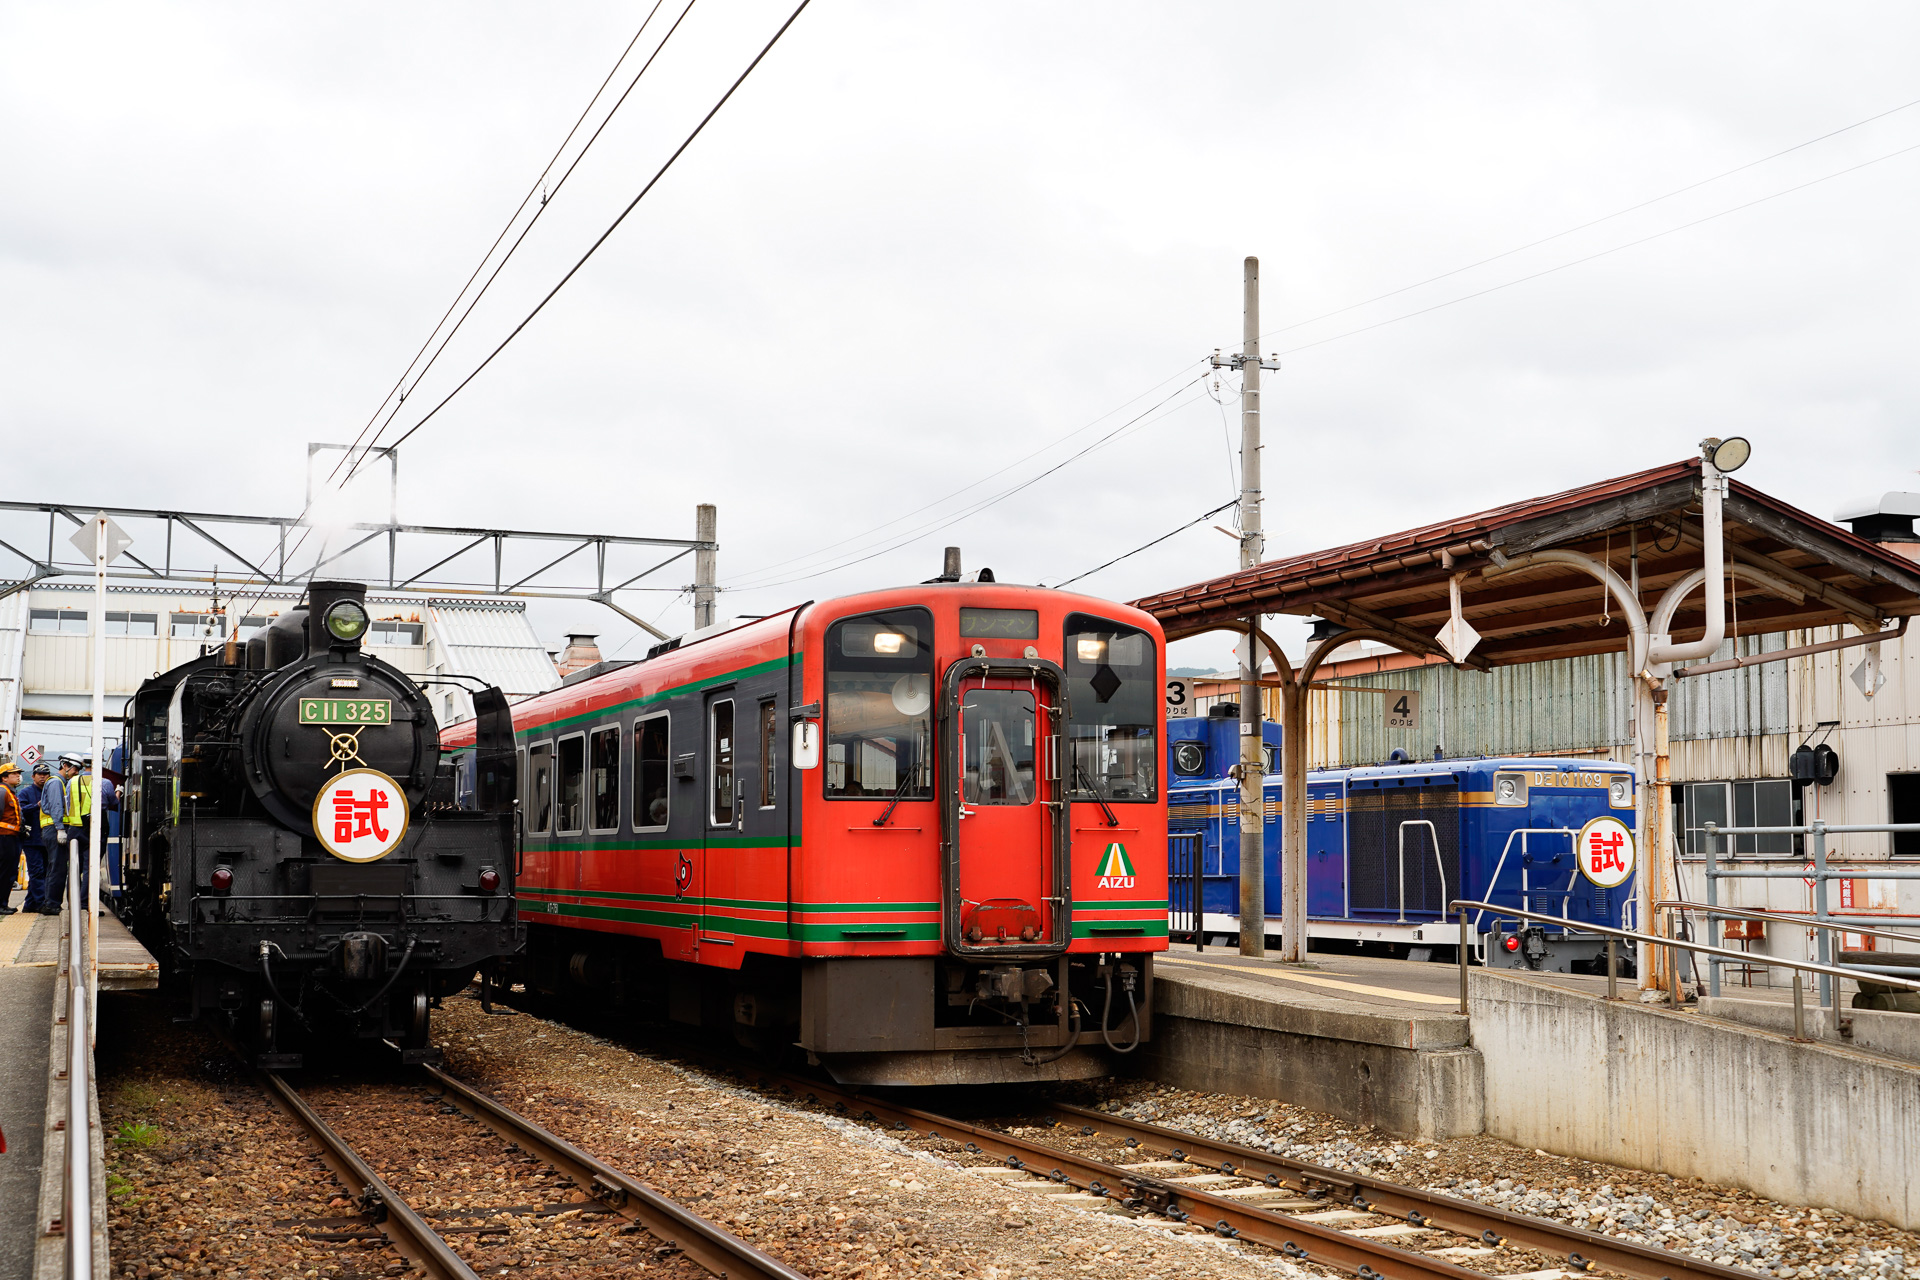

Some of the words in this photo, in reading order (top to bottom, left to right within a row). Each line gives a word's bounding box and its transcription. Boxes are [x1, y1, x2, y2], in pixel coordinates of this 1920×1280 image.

[961, 616, 1034, 634] ワンマン
[1166, 681, 1186, 705] 3
[345, 703, 386, 721] 325
[1393, 695, 1411, 718] 4
[1390, 719, 1413, 727] のりば
[28, 751, 35, 760] 2
[1534, 772, 1569, 787] DE10
[1573, 772, 1602, 787] 1109
[332, 789, 389, 843] 試
[1589, 831, 1625, 873] 試
[1097, 876, 1135, 889] AIZU
